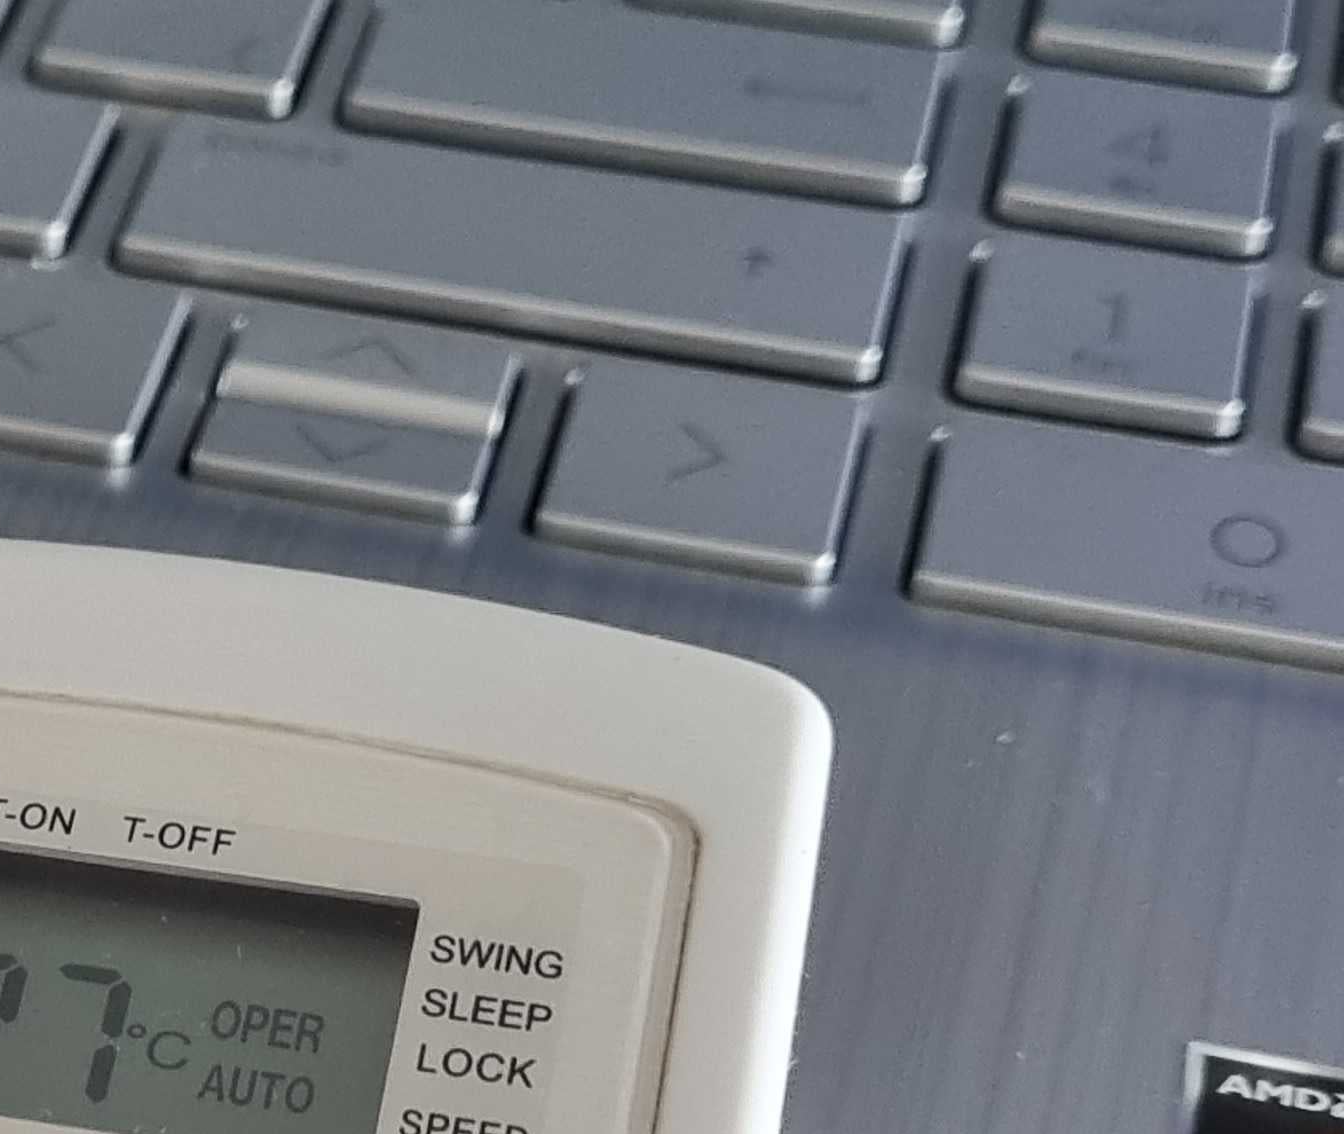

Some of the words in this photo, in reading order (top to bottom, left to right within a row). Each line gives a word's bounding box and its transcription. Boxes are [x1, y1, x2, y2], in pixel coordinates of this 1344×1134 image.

[124, 816, 236, 855] T-OFF
[431, 935, 563, 979] SWING
[212, 1001, 324, 1053] OPER
[422, 989, 552, 1031] SLEEP
[417, 1044, 535, 1088] LOCK
[197, 1067, 314, 1114] AUTO
